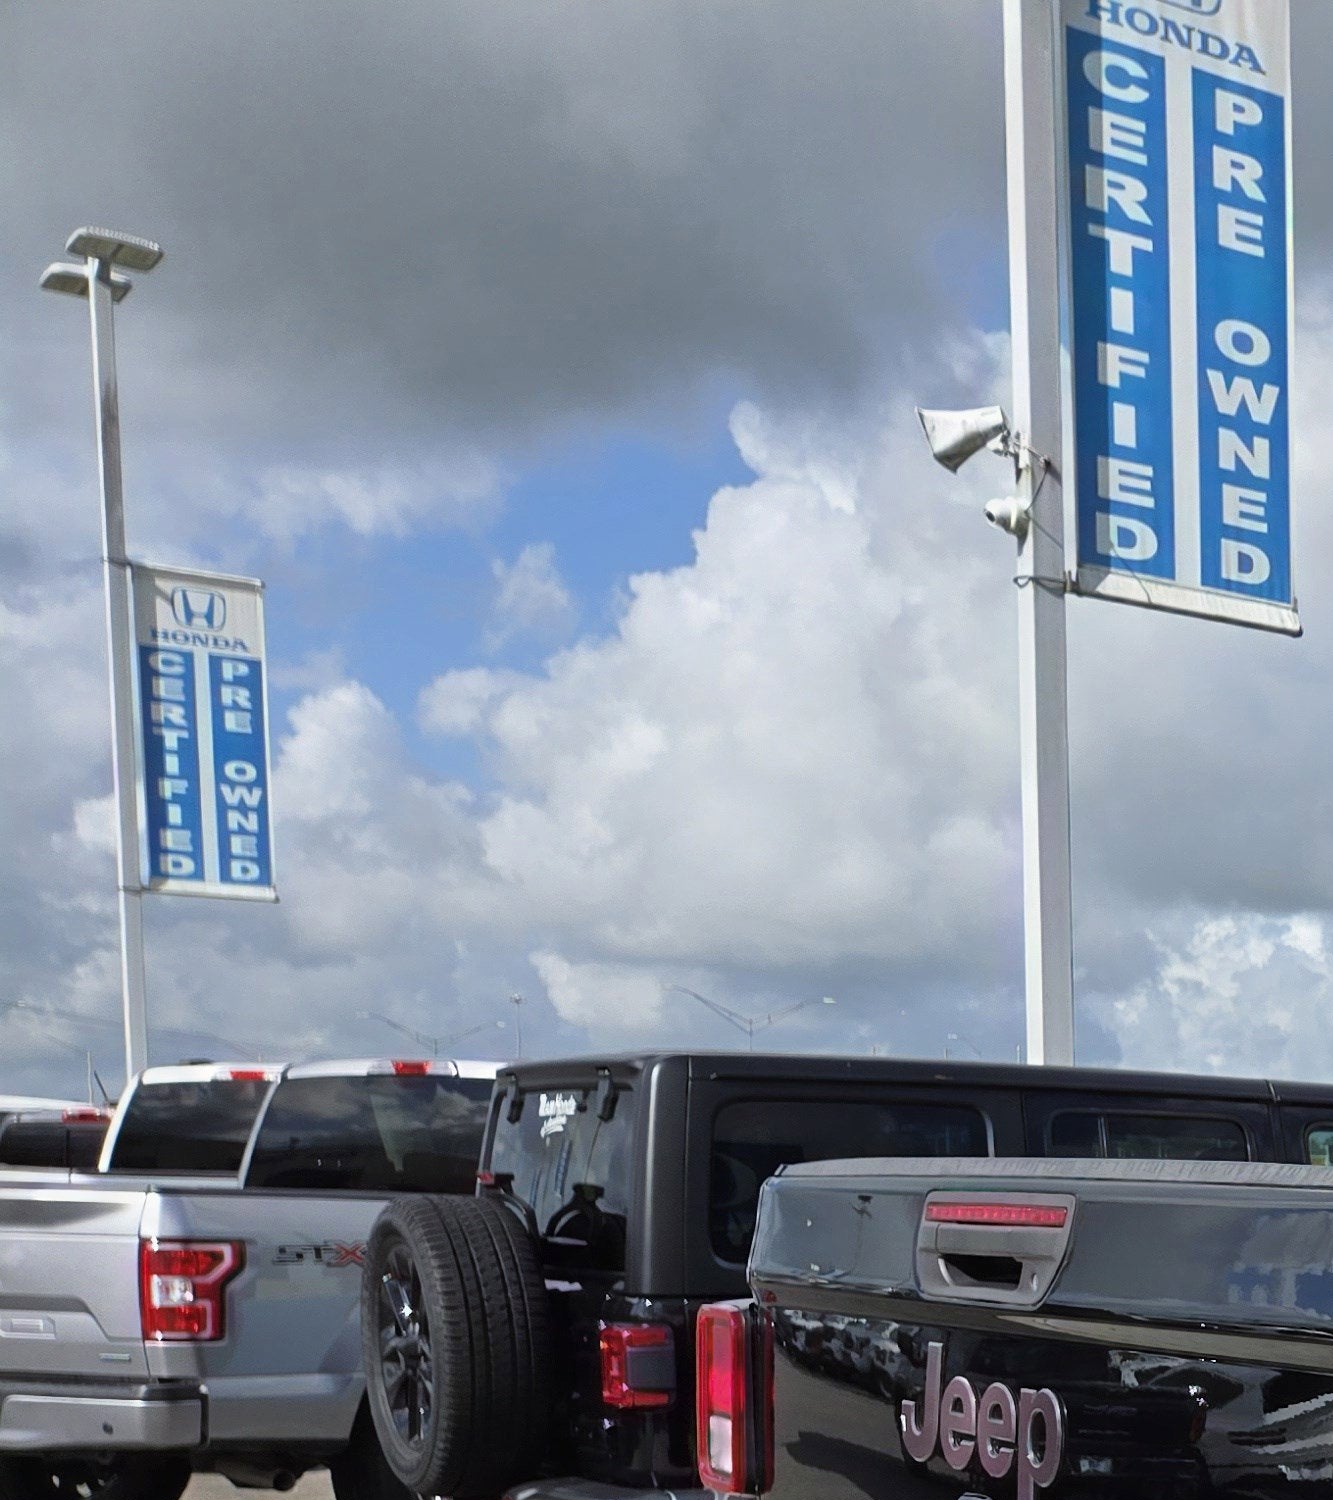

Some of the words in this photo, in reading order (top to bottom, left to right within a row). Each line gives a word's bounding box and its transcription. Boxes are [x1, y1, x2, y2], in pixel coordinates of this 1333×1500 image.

[1084, 0, 1267, 76] HONDA
[1211, 87, 1268, 259] PRE
[1082, 48, 1158, 562] CERTIFIED
[1206, 317, 1280, 586] OWNED
[149, 625, 249, 653] HONDA
[220, 658, 253, 735] PRE
[149, 650, 196, 878] CERTIFIED
[219, 759, 263, 883] OWNED
